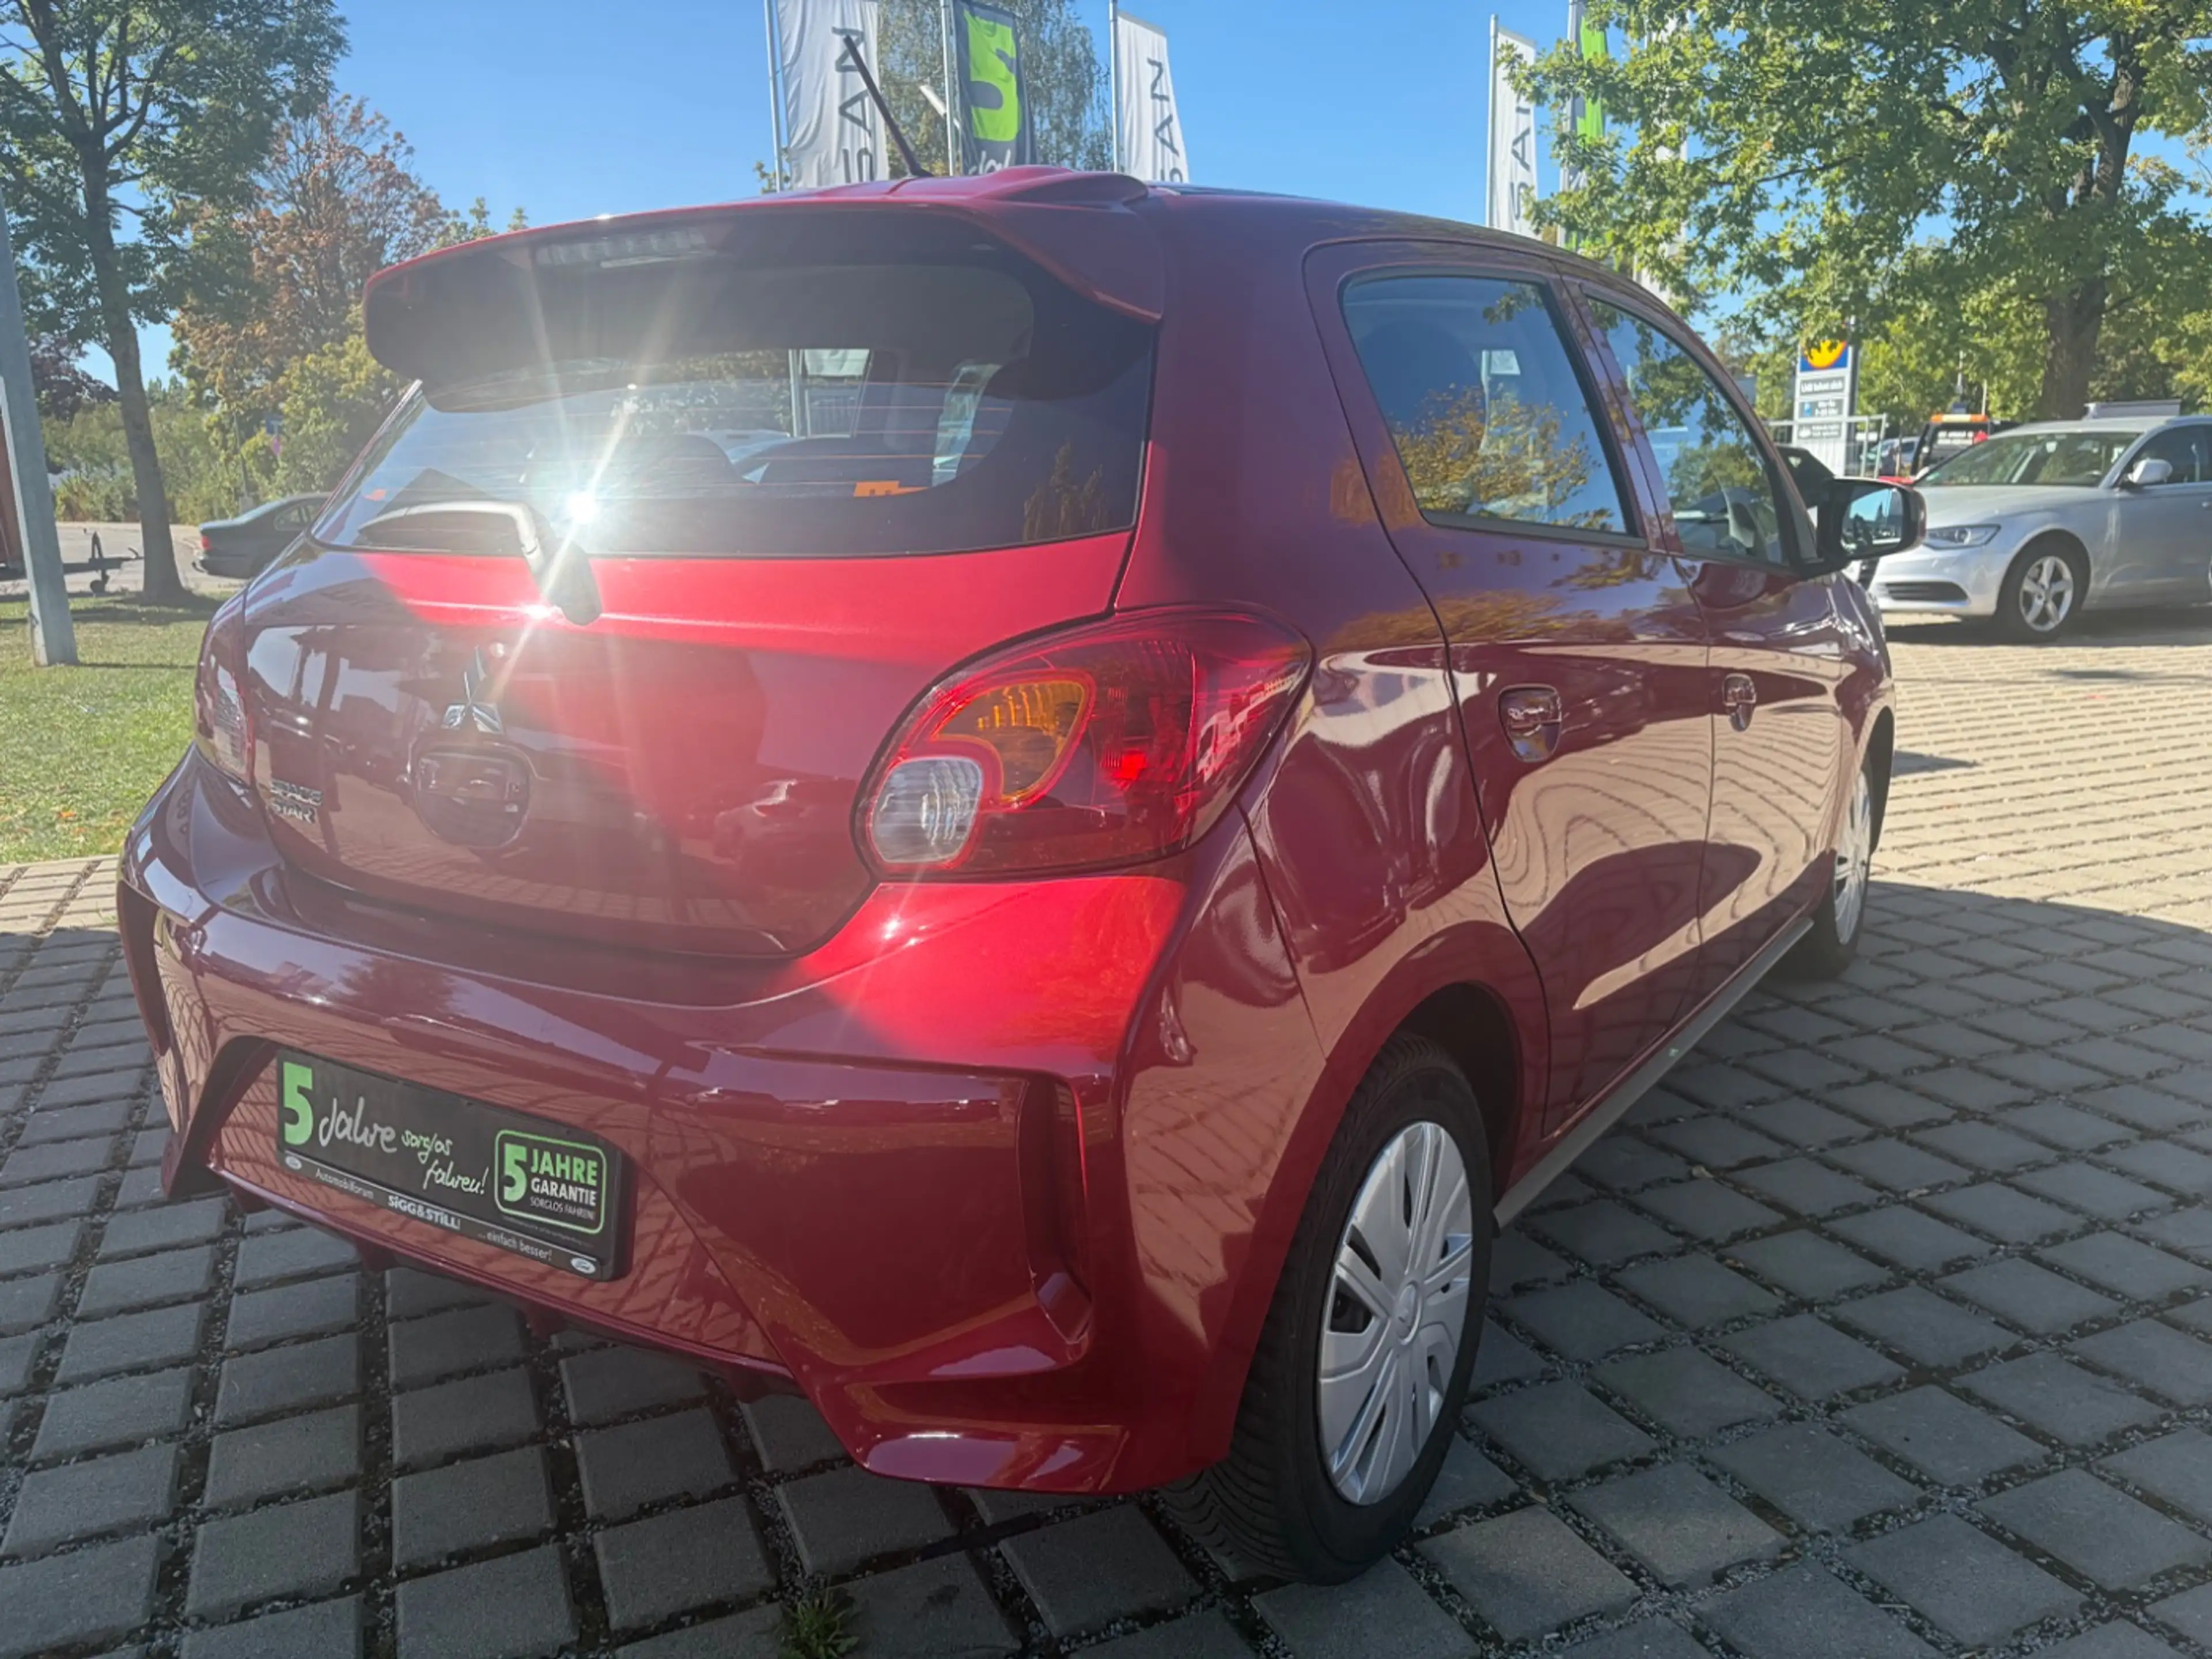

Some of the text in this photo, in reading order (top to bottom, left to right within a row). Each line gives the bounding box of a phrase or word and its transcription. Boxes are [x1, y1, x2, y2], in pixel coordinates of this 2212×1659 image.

[963, 8, 1022, 141] 5
[282, 1061, 453, 1165] 5 Jahre sorglos
[422, 1159, 490, 1195] fahren!
[503, 1143, 598, 1202] 5 JAHRE
[531, 1177, 597, 1207] GARANTIE
[530, 1196, 563, 1214] SORGLOS
